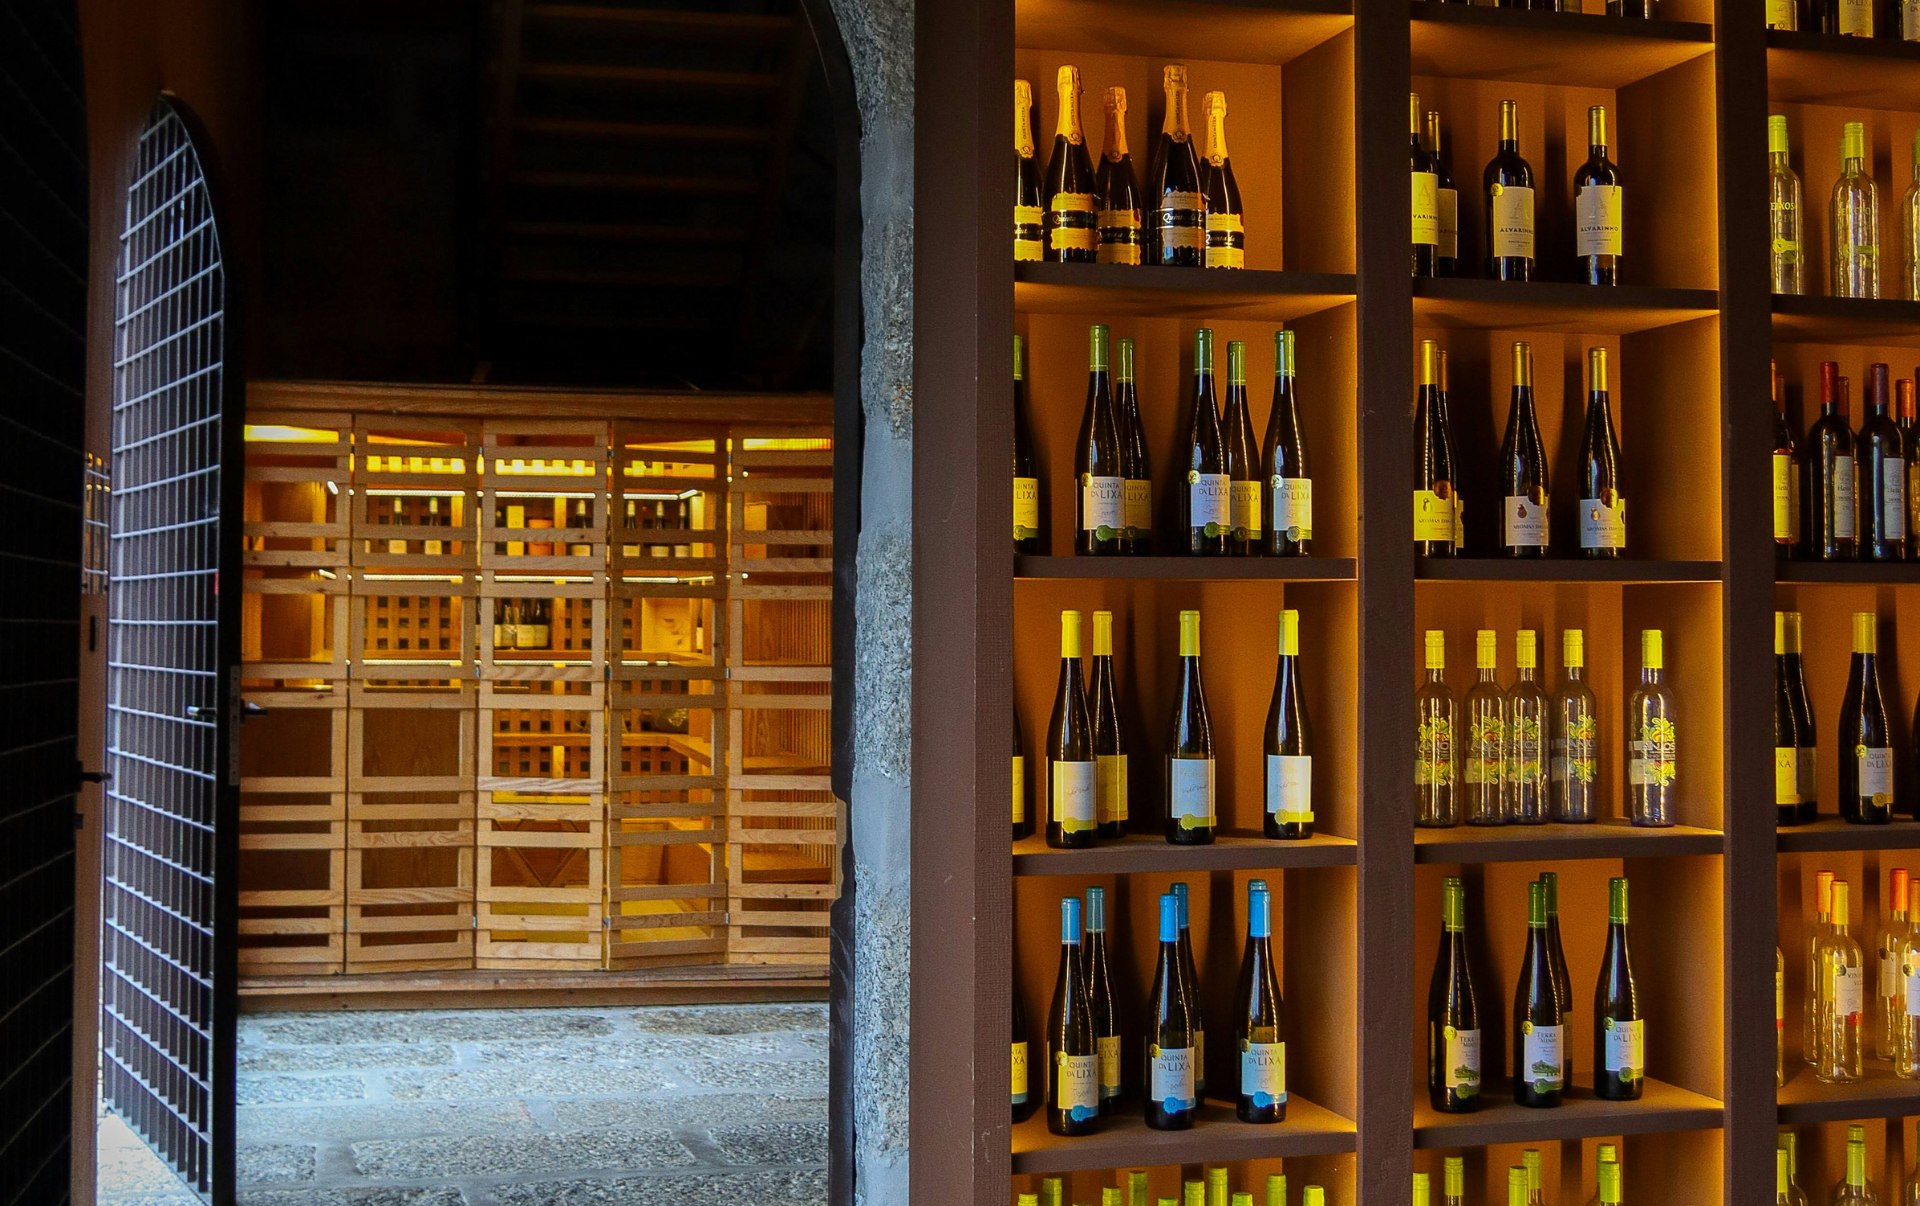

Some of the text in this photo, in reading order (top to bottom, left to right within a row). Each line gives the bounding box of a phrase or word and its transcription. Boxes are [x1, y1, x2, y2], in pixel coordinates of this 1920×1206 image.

[1093, 482, 1120, 490] QUINTA
[1200, 479, 1226, 487] QUINTA
[1284, 482, 1309, 491] QUINTA
[1016, 491, 1037, 500] LIXA
[1100, 489, 1123, 500] LIXA
[1208, 486, 1229, 497] LIXA
[1291, 490, 1311, 501] LIXA
[1237, 494, 1260, 503] LIXA
[1250, 1048, 1279, 1056] QUINTA
[1258, 1056, 1282, 1066] LIXA
[1168, 1060, 1192, 1072] LIXA
[1076, 1069, 1097, 1080] LIXA
